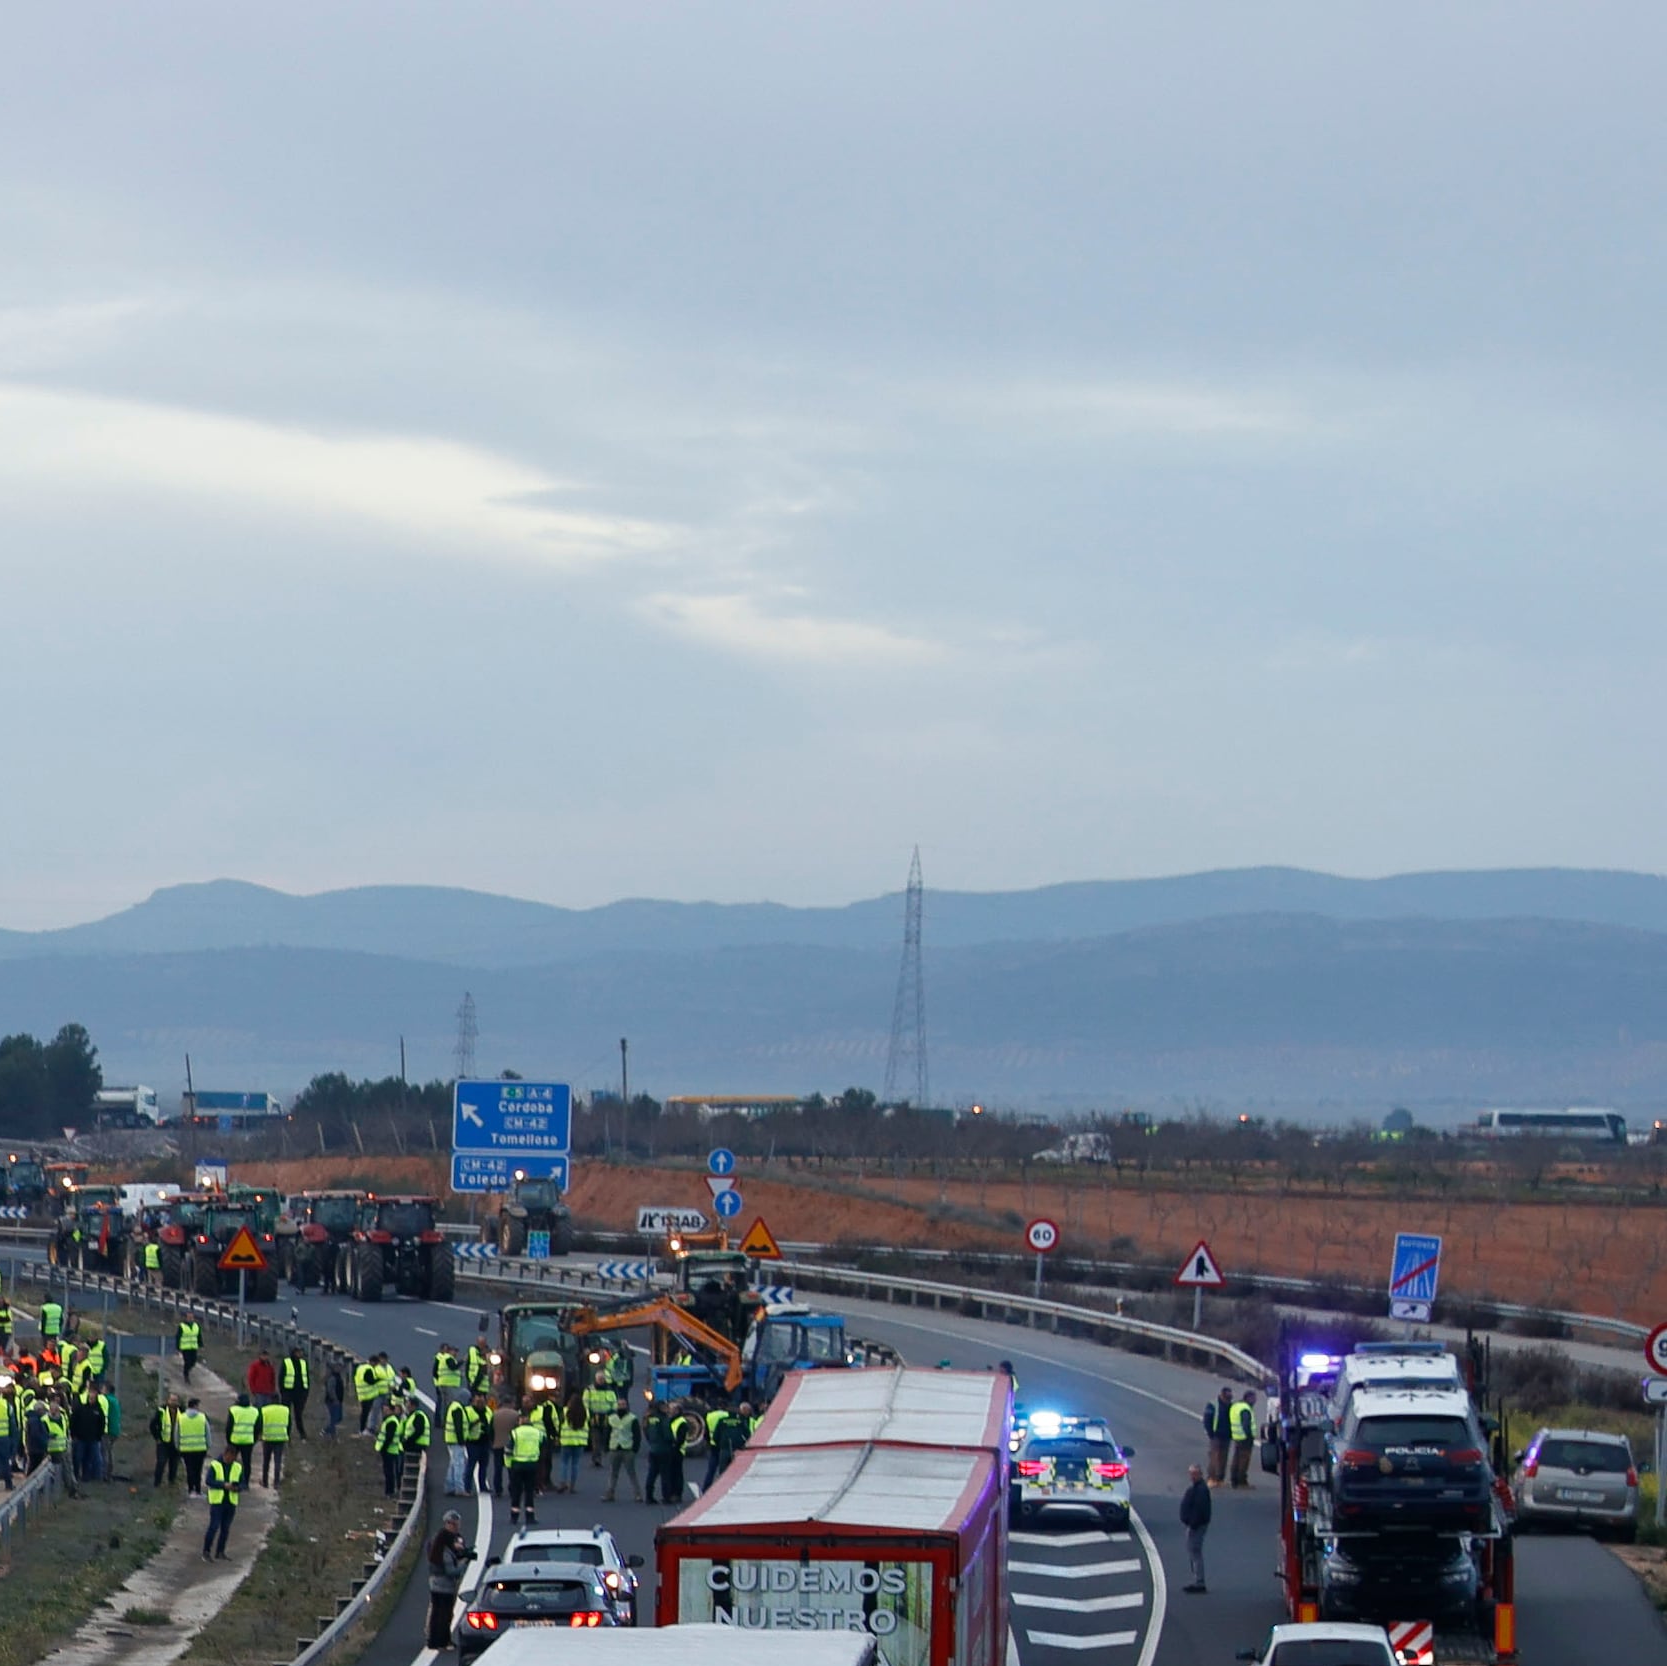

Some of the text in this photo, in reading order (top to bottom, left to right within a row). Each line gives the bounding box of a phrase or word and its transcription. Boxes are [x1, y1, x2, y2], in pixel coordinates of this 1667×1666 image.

[506, 1117, 548, 1129] CM-42
[491, 1132, 558, 1146] Tomelloso
[459, 1173, 507, 1185] Toledo
[1033, 1229, 1052, 1242] 60
[706, 1564, 907, 1594] CUIDEMOS
[714, 1604, 899, 1636] NUESTRO
